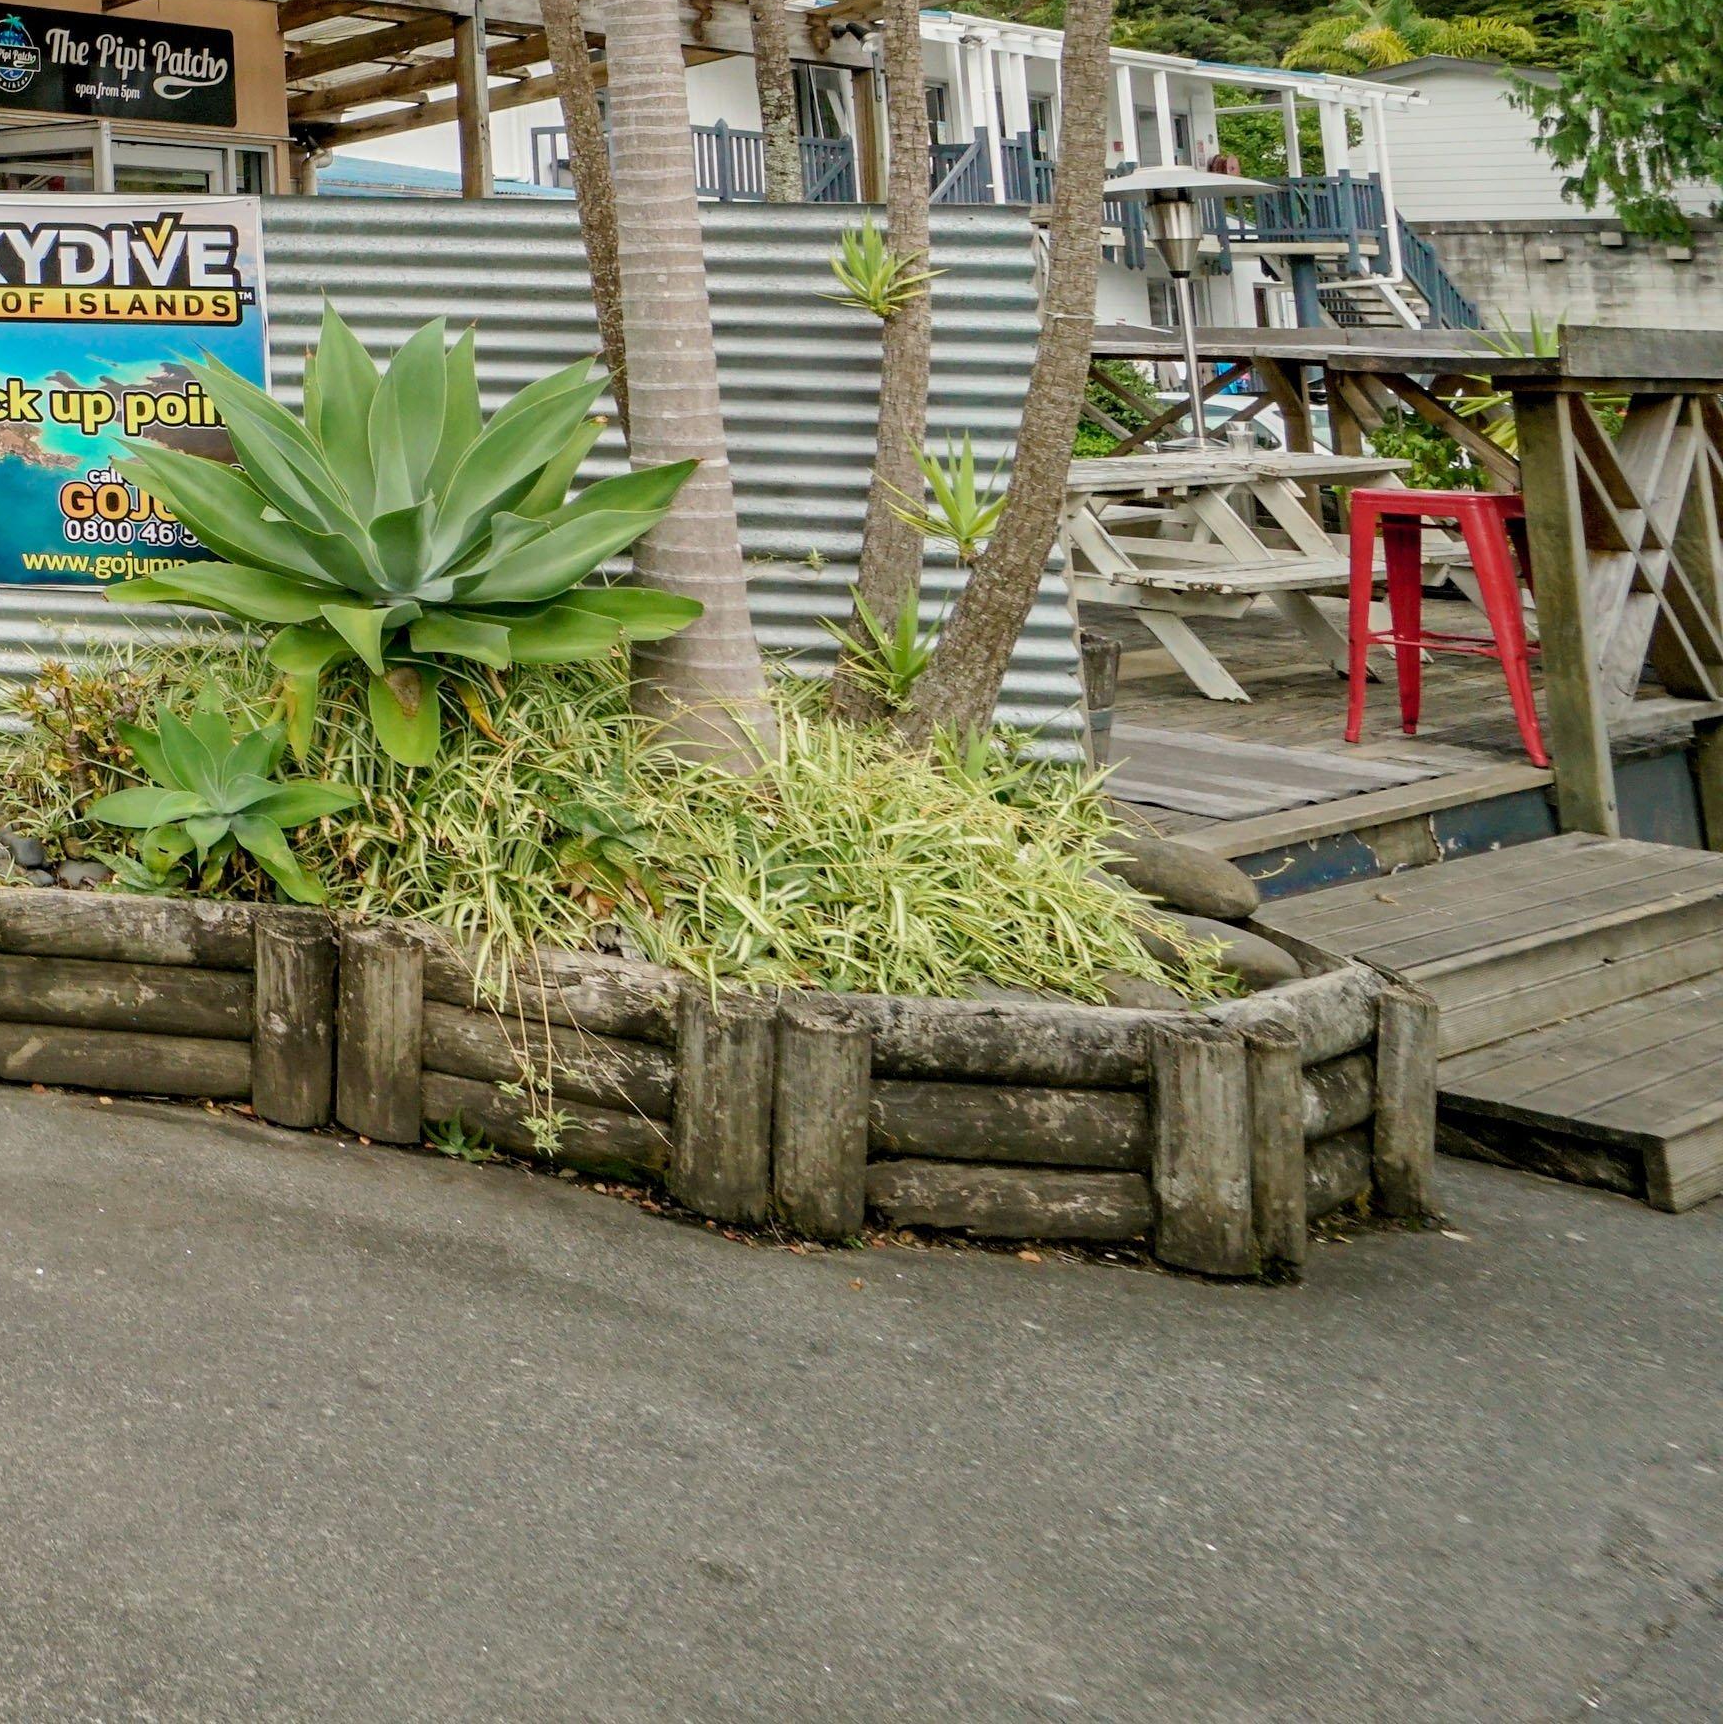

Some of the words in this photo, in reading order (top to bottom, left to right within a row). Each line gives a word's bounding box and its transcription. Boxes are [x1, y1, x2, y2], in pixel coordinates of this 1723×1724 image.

[45, 28, 89, 66] The
[96, 34, 146, 80] Pipi
[152, 40, 229, 100] Patch
[75, 83, 96, 98] open
[96, 82, 119, 99] from
[120, 83, 141, 101] 5pm
[1, 291, 45, 313] OF
[64, 292, 232, 317] ISLANDS
[51, 393, 113, 433] up
[66, 521, 133, 542] 0800
[141, 522, 175, 544] 46
